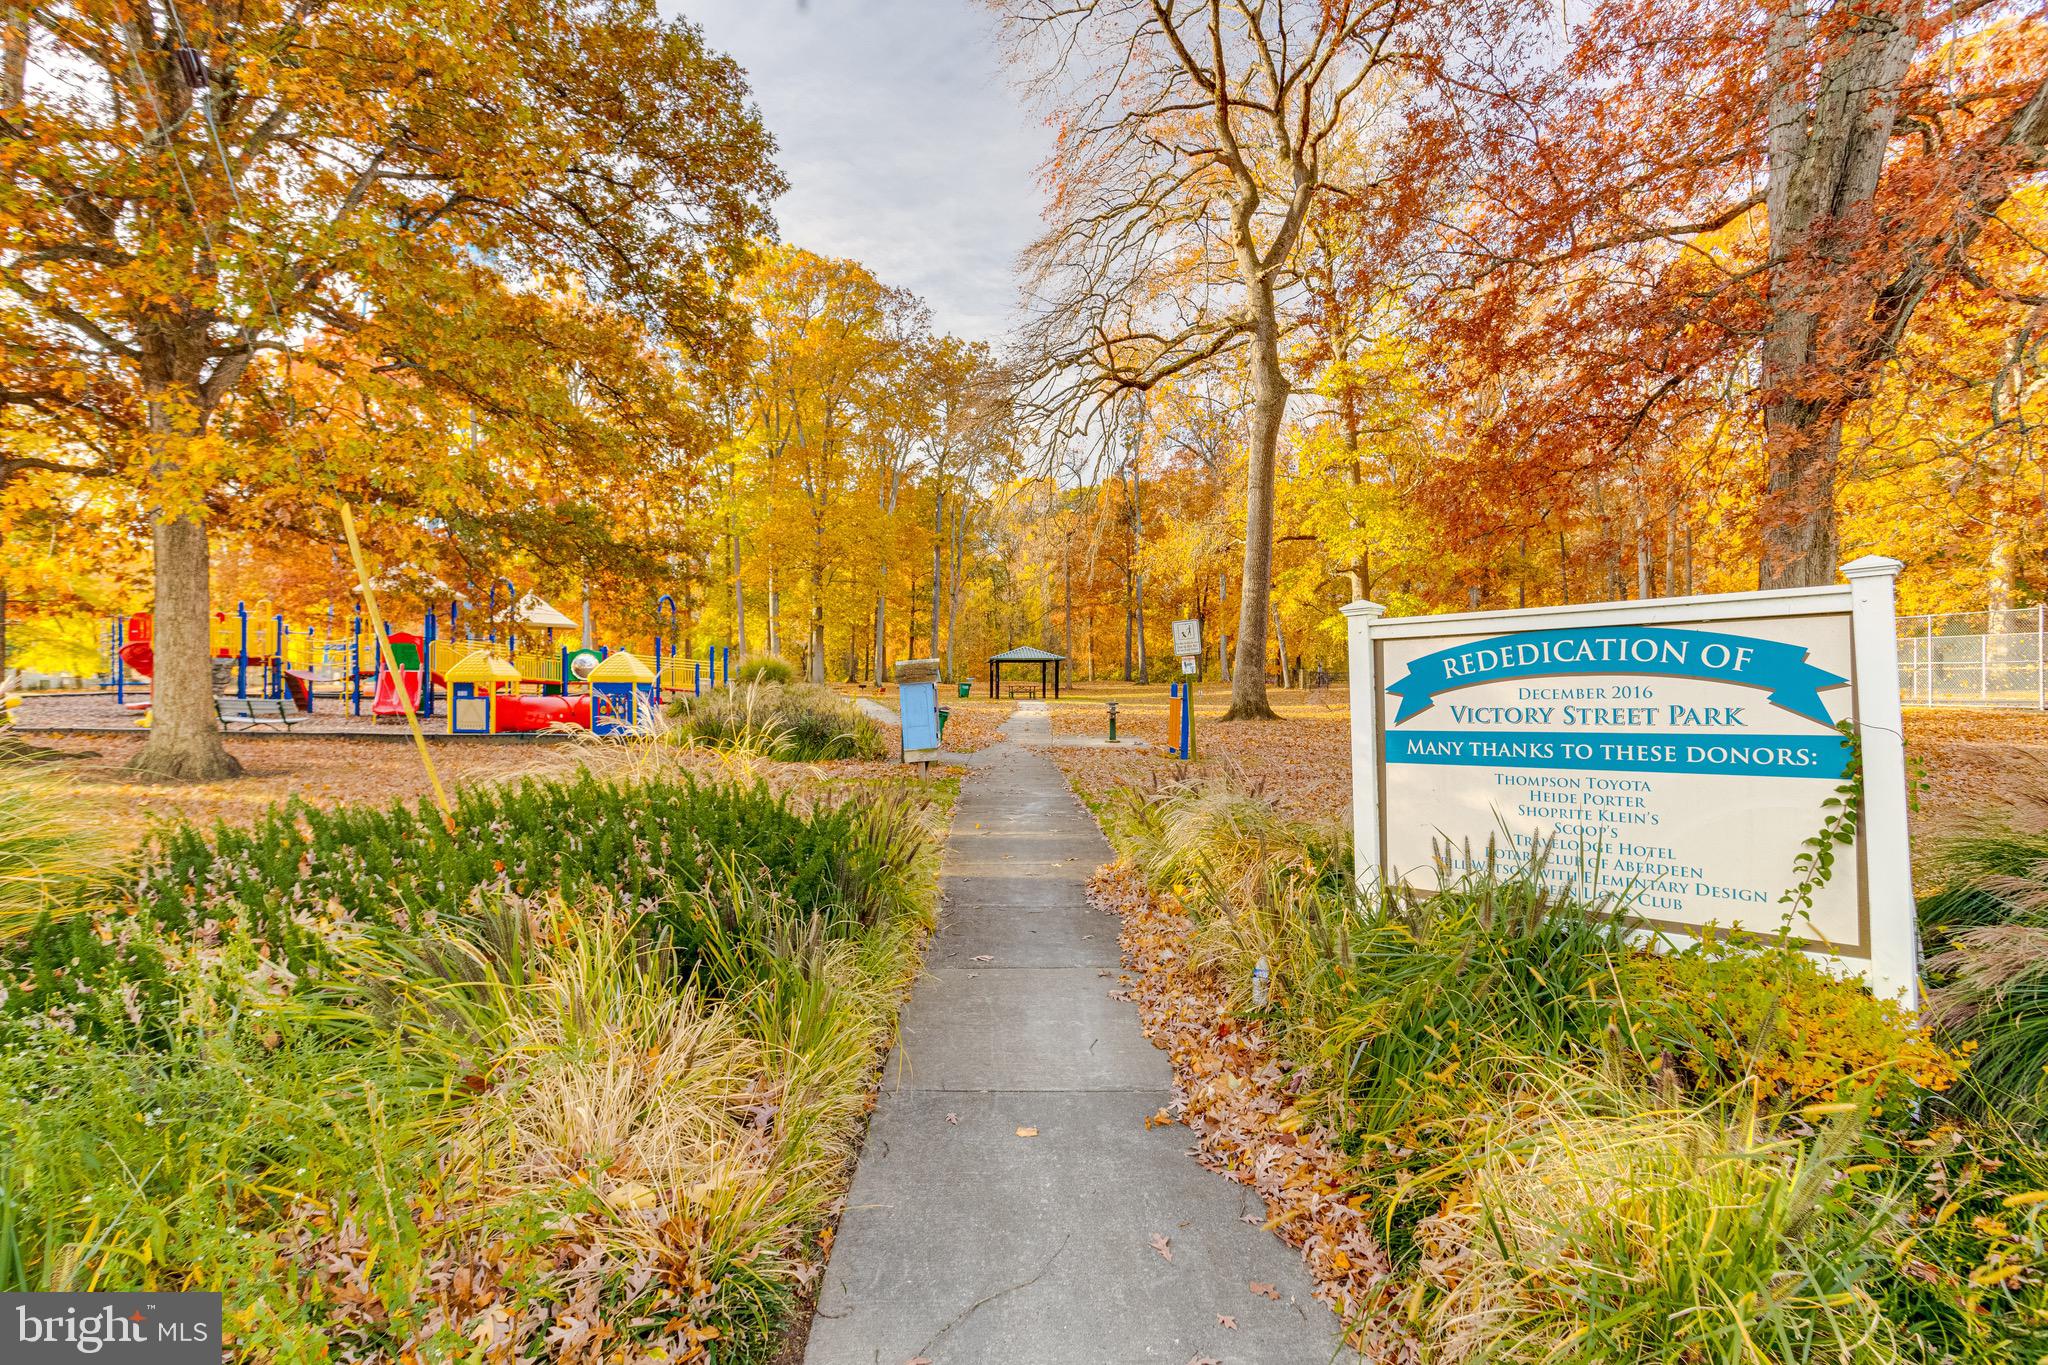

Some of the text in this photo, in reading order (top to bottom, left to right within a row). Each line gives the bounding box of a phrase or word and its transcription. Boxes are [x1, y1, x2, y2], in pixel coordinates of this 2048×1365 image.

[1442, 638, 1754, 679] REDEDICATION OF
[1519, 685, 1653, 701] DECEMBER 2016
[1450, 705, 1749, 727] VICTORY STREET PARK
[1406, 738, 1818, 766] MANY THANKS TO THESE DONORS:
[1494, 773, 1652, 792] THOMPSON TOYOTA
[1530, 791, 1646, 809] HEIDE PORTER
[1518, 805, 1660, 826] SHOPRITE KLEIN'S
[1619, 843, 1677, 860] HOTEL
[1485, 847, 1537, 862] OTAR
[1614, 859, 1703, 879] ABERDEEN
[1471, 859, 1532, 877] WTSON
[1696, 882, 1768, 903] DESIGN
[1584, 886, 1633, 904] LONS
[1638, 893, 1684, 911] CLUB
